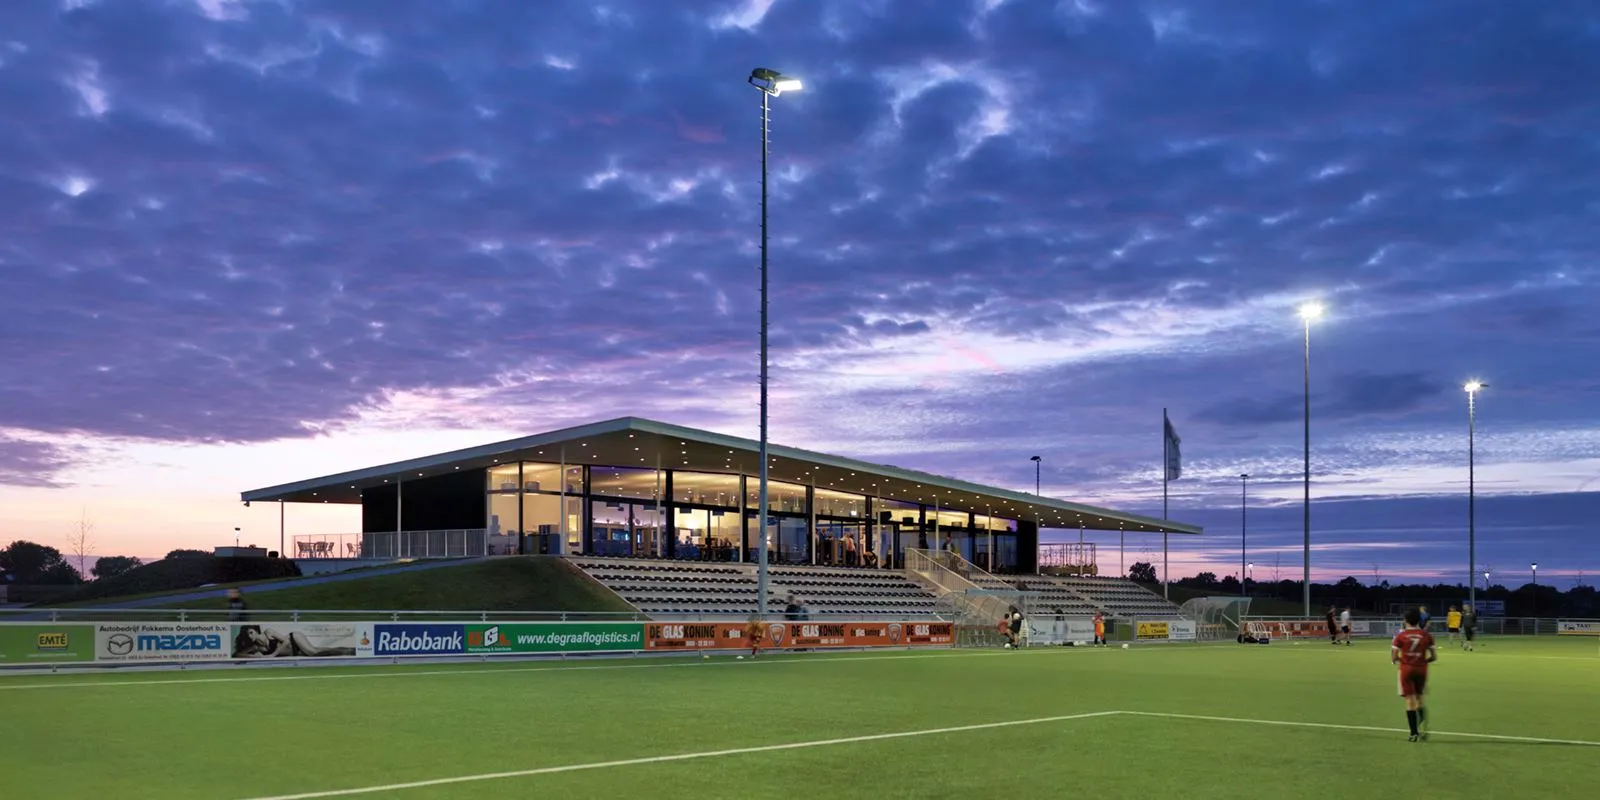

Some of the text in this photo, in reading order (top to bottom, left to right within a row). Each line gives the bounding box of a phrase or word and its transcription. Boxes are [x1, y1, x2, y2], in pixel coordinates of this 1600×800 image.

[650, 625, 661, 638] DE
[663, 625, 715, 639] GLASKONING
[791, 625, 801, 637] DE
[802, 624, 845, 637] GLASKONING
[906, 625, 914, 636] DE
[39, 633, 66, 645] EMTÉ
[137, 634, 221, 651] mazda
[378, 631, 463, 651] Rabobank
[517, 631, 640, 646] www.degraaflogistics.nl
[1409, 638, 1420, 652] 7
